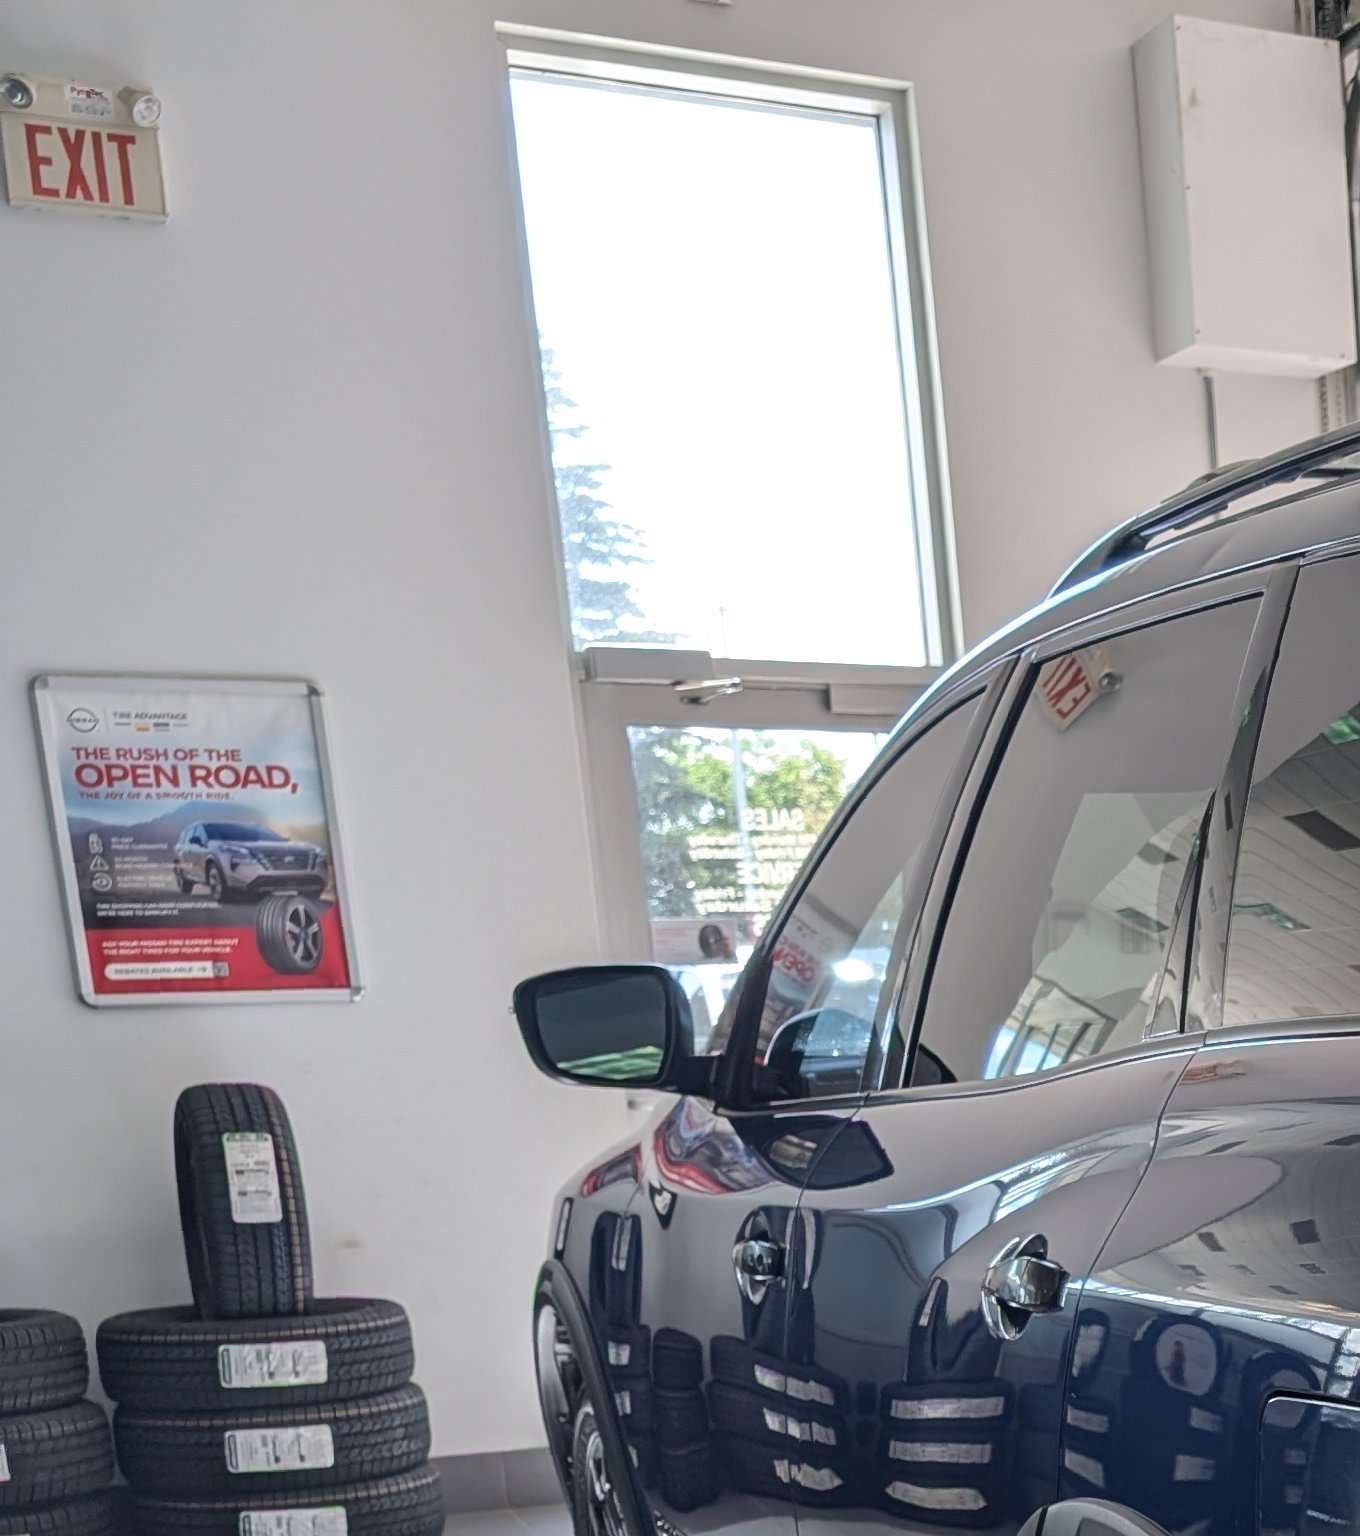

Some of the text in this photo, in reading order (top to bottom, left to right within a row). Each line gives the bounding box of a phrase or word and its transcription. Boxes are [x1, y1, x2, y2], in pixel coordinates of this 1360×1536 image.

[24, 123, 136, 206] EXIT
[71, 746, 242, 762] THE RUSH OF THE
[75, 763, 298, 794] OPEN ROAD,
[80, 792, 101, 800] THE
